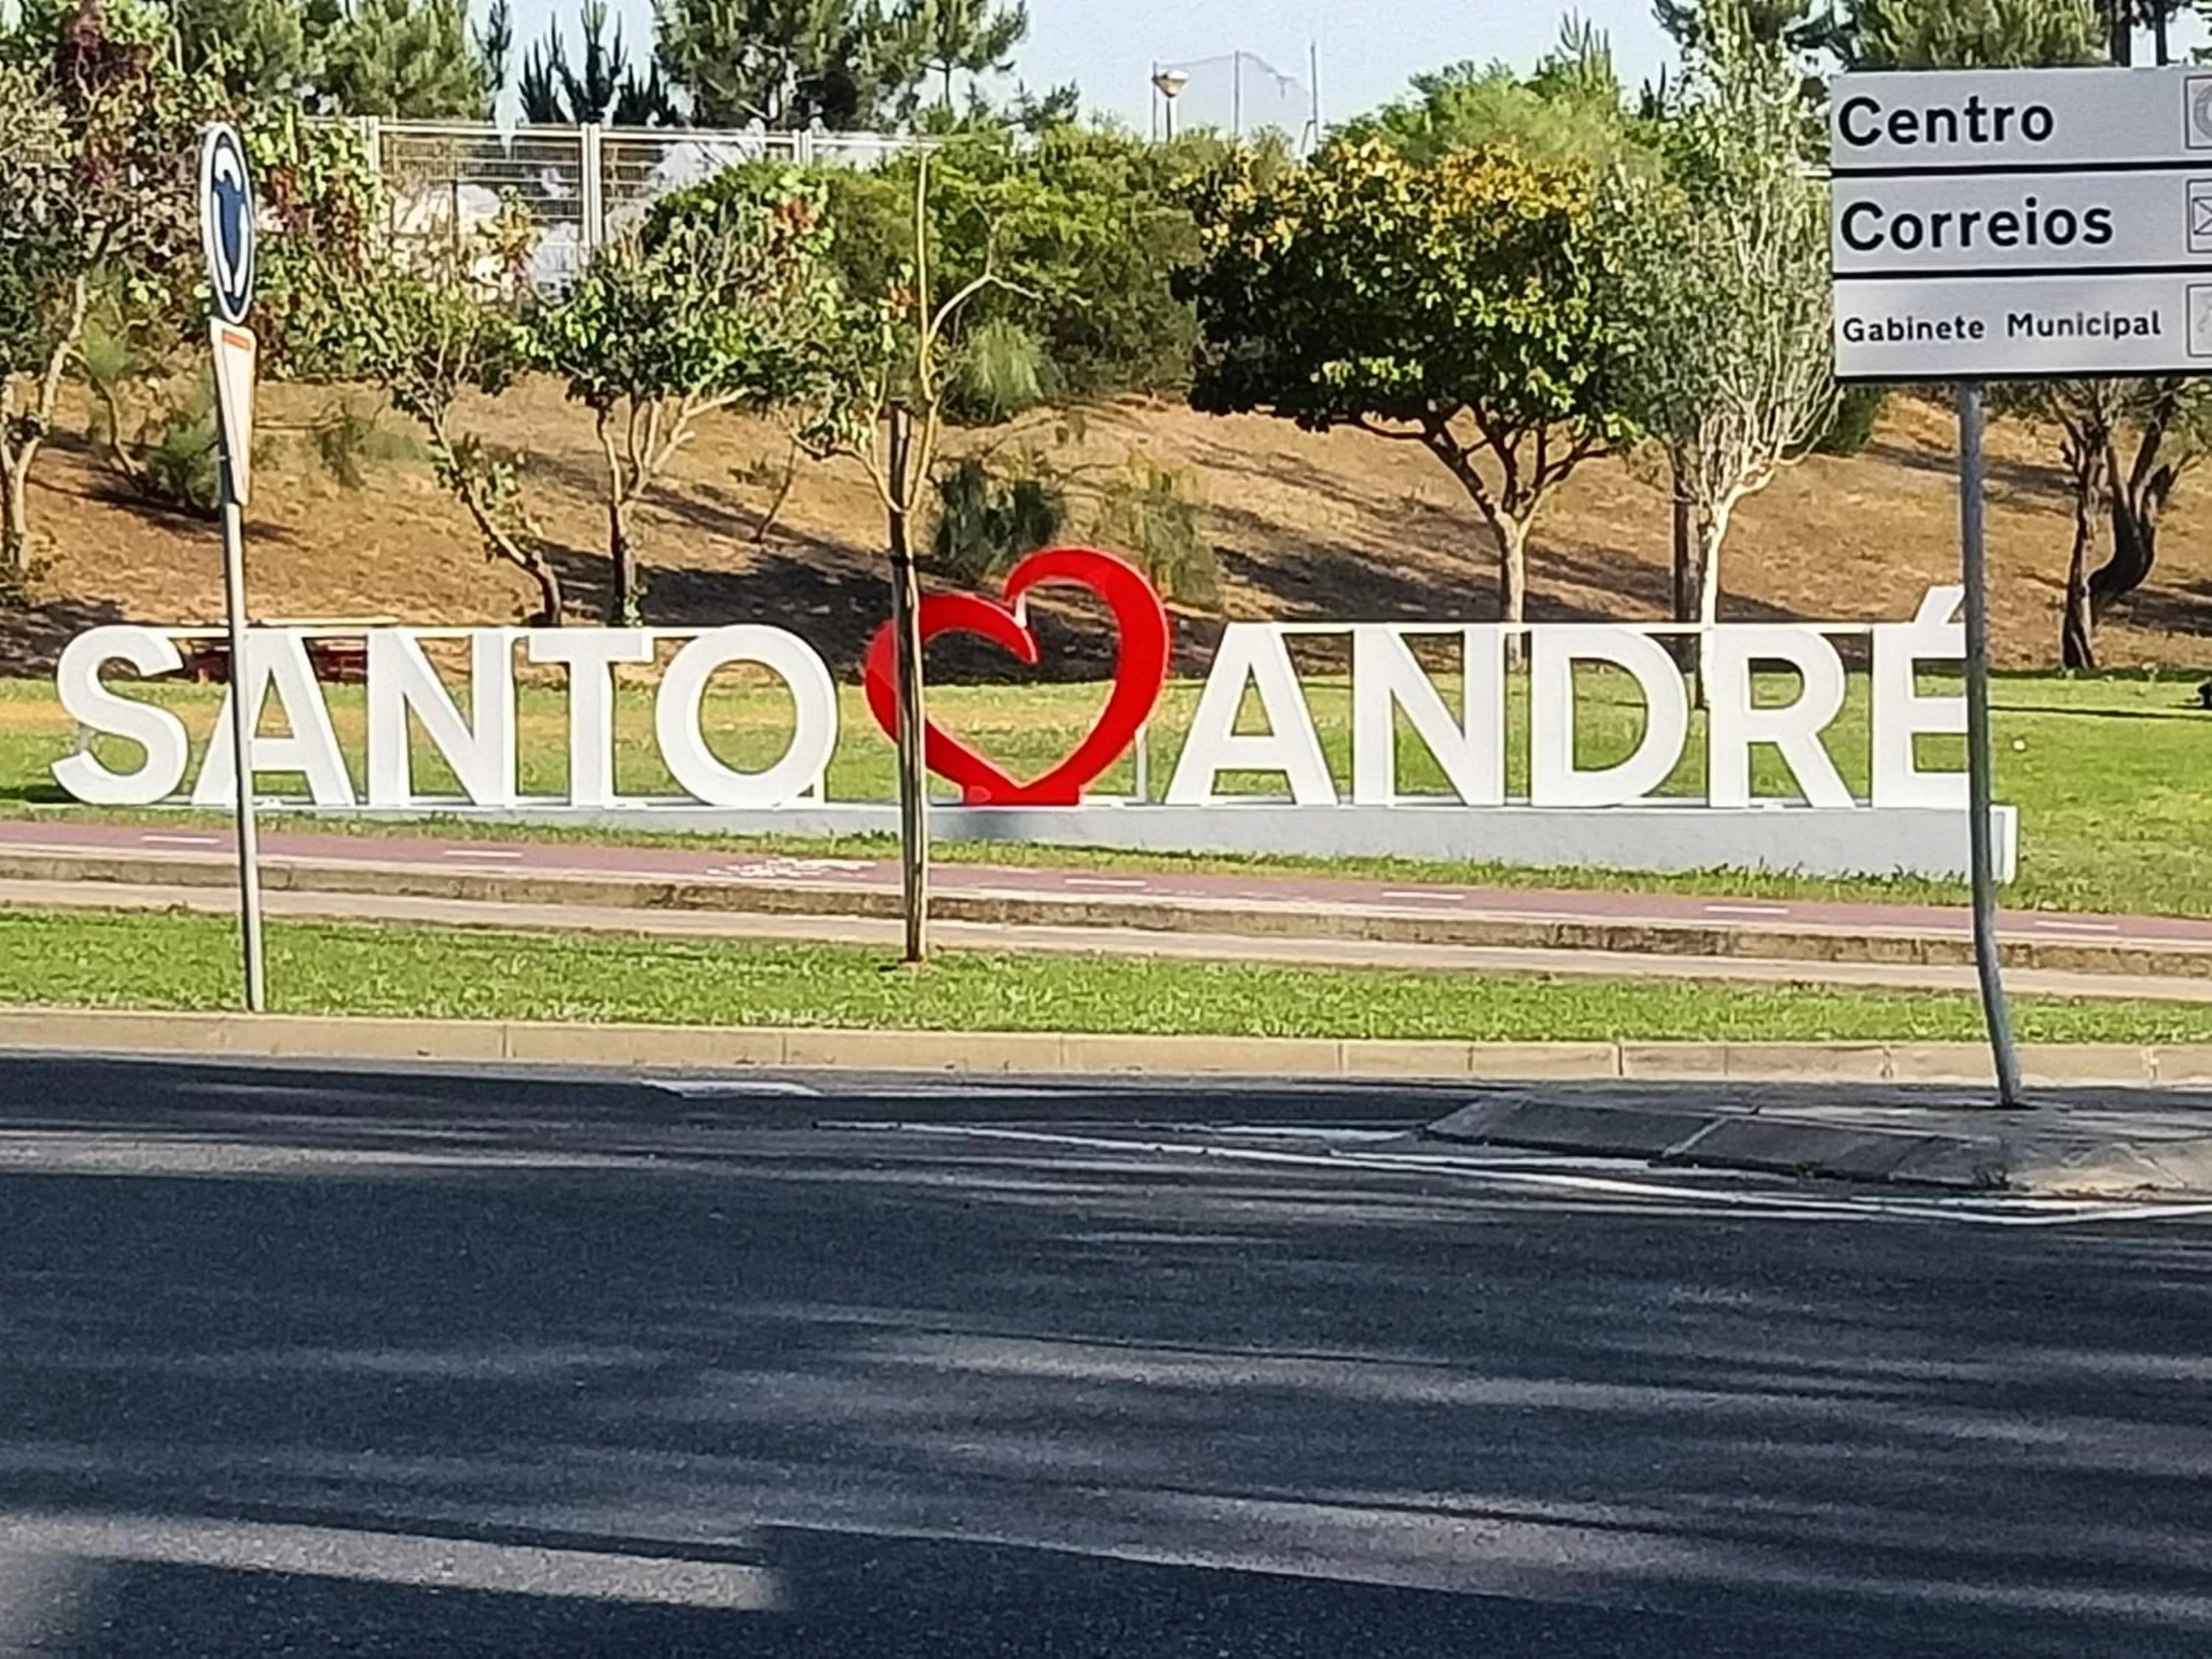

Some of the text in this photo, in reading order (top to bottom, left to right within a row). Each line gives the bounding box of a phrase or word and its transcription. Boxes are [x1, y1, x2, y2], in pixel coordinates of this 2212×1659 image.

[1838, 95, 2054, 147] Centro
[1841, 196, 2113, 251] Correios
[1843, 310, 2162, 342] Gabinete Municipal
[50, 585, 1969, 808] SANTO ANDRÉ
